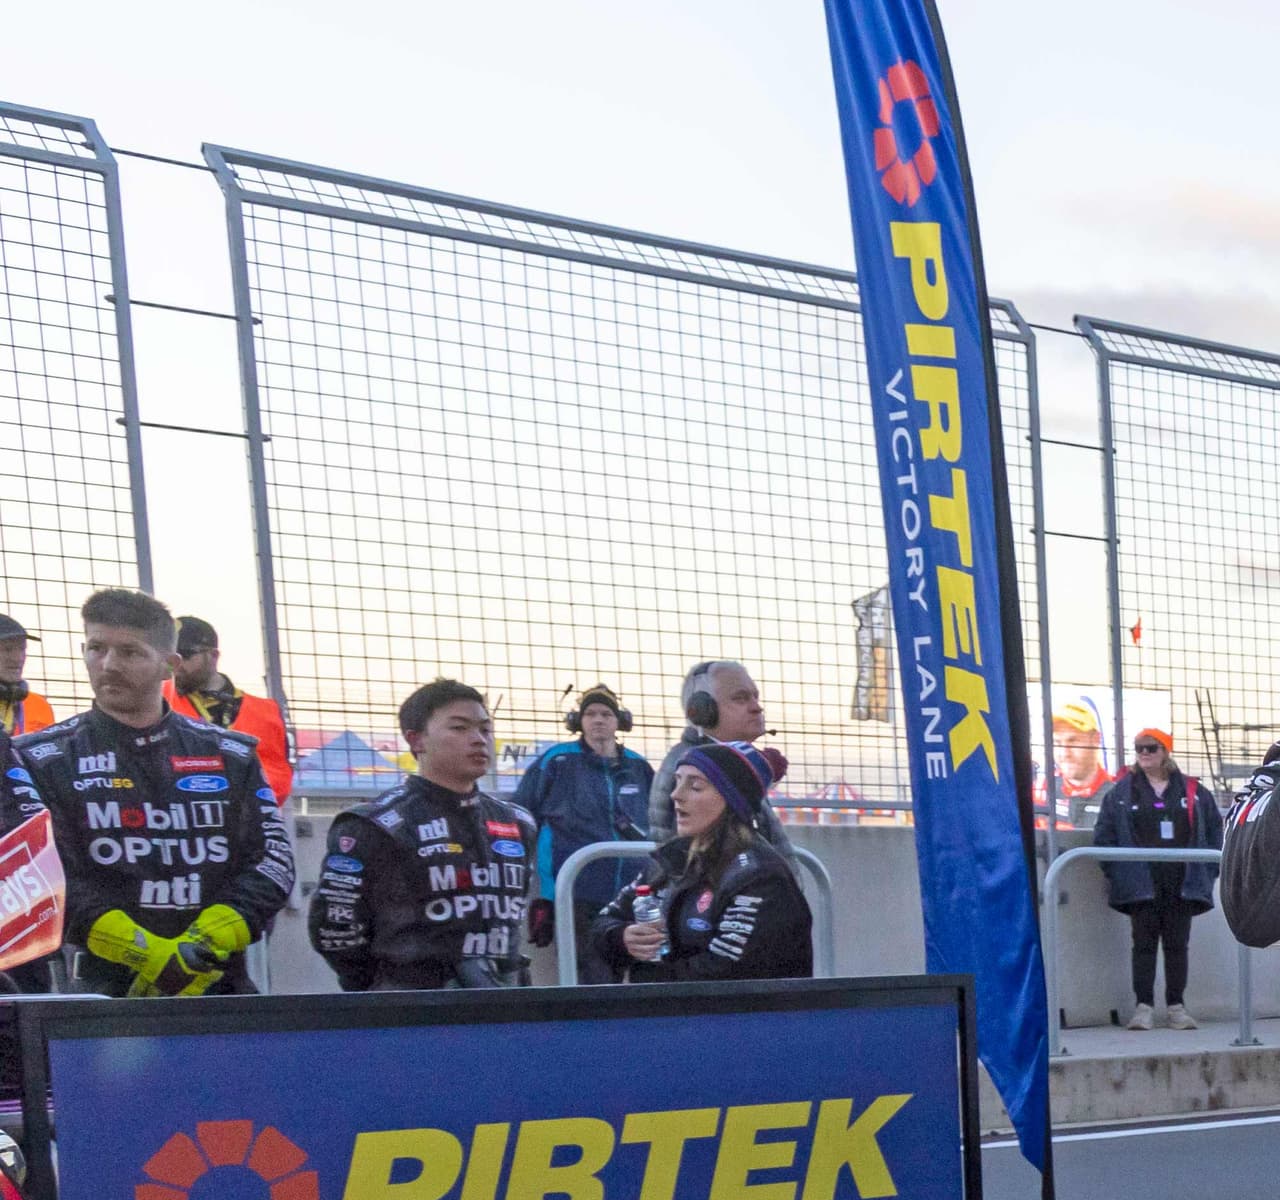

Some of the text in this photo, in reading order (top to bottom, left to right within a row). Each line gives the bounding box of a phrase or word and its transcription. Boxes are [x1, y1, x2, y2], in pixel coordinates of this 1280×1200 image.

[890, 221, 999, 784] PIRTEK
[886, 369, 947, 780] VICTORY LANE
[79, 751, 117, 773] nti
[87, 802, 188, 830] Mobil
[418, 817, 448, 842] nti
[89, 836, 229, 865] OPTUS
[140, 873, 202, 905] nti
[429, 862, 499, 892] Mobil
[425, 894, 526, 921] OPTUS
[463, 926, 510, 956] nti
